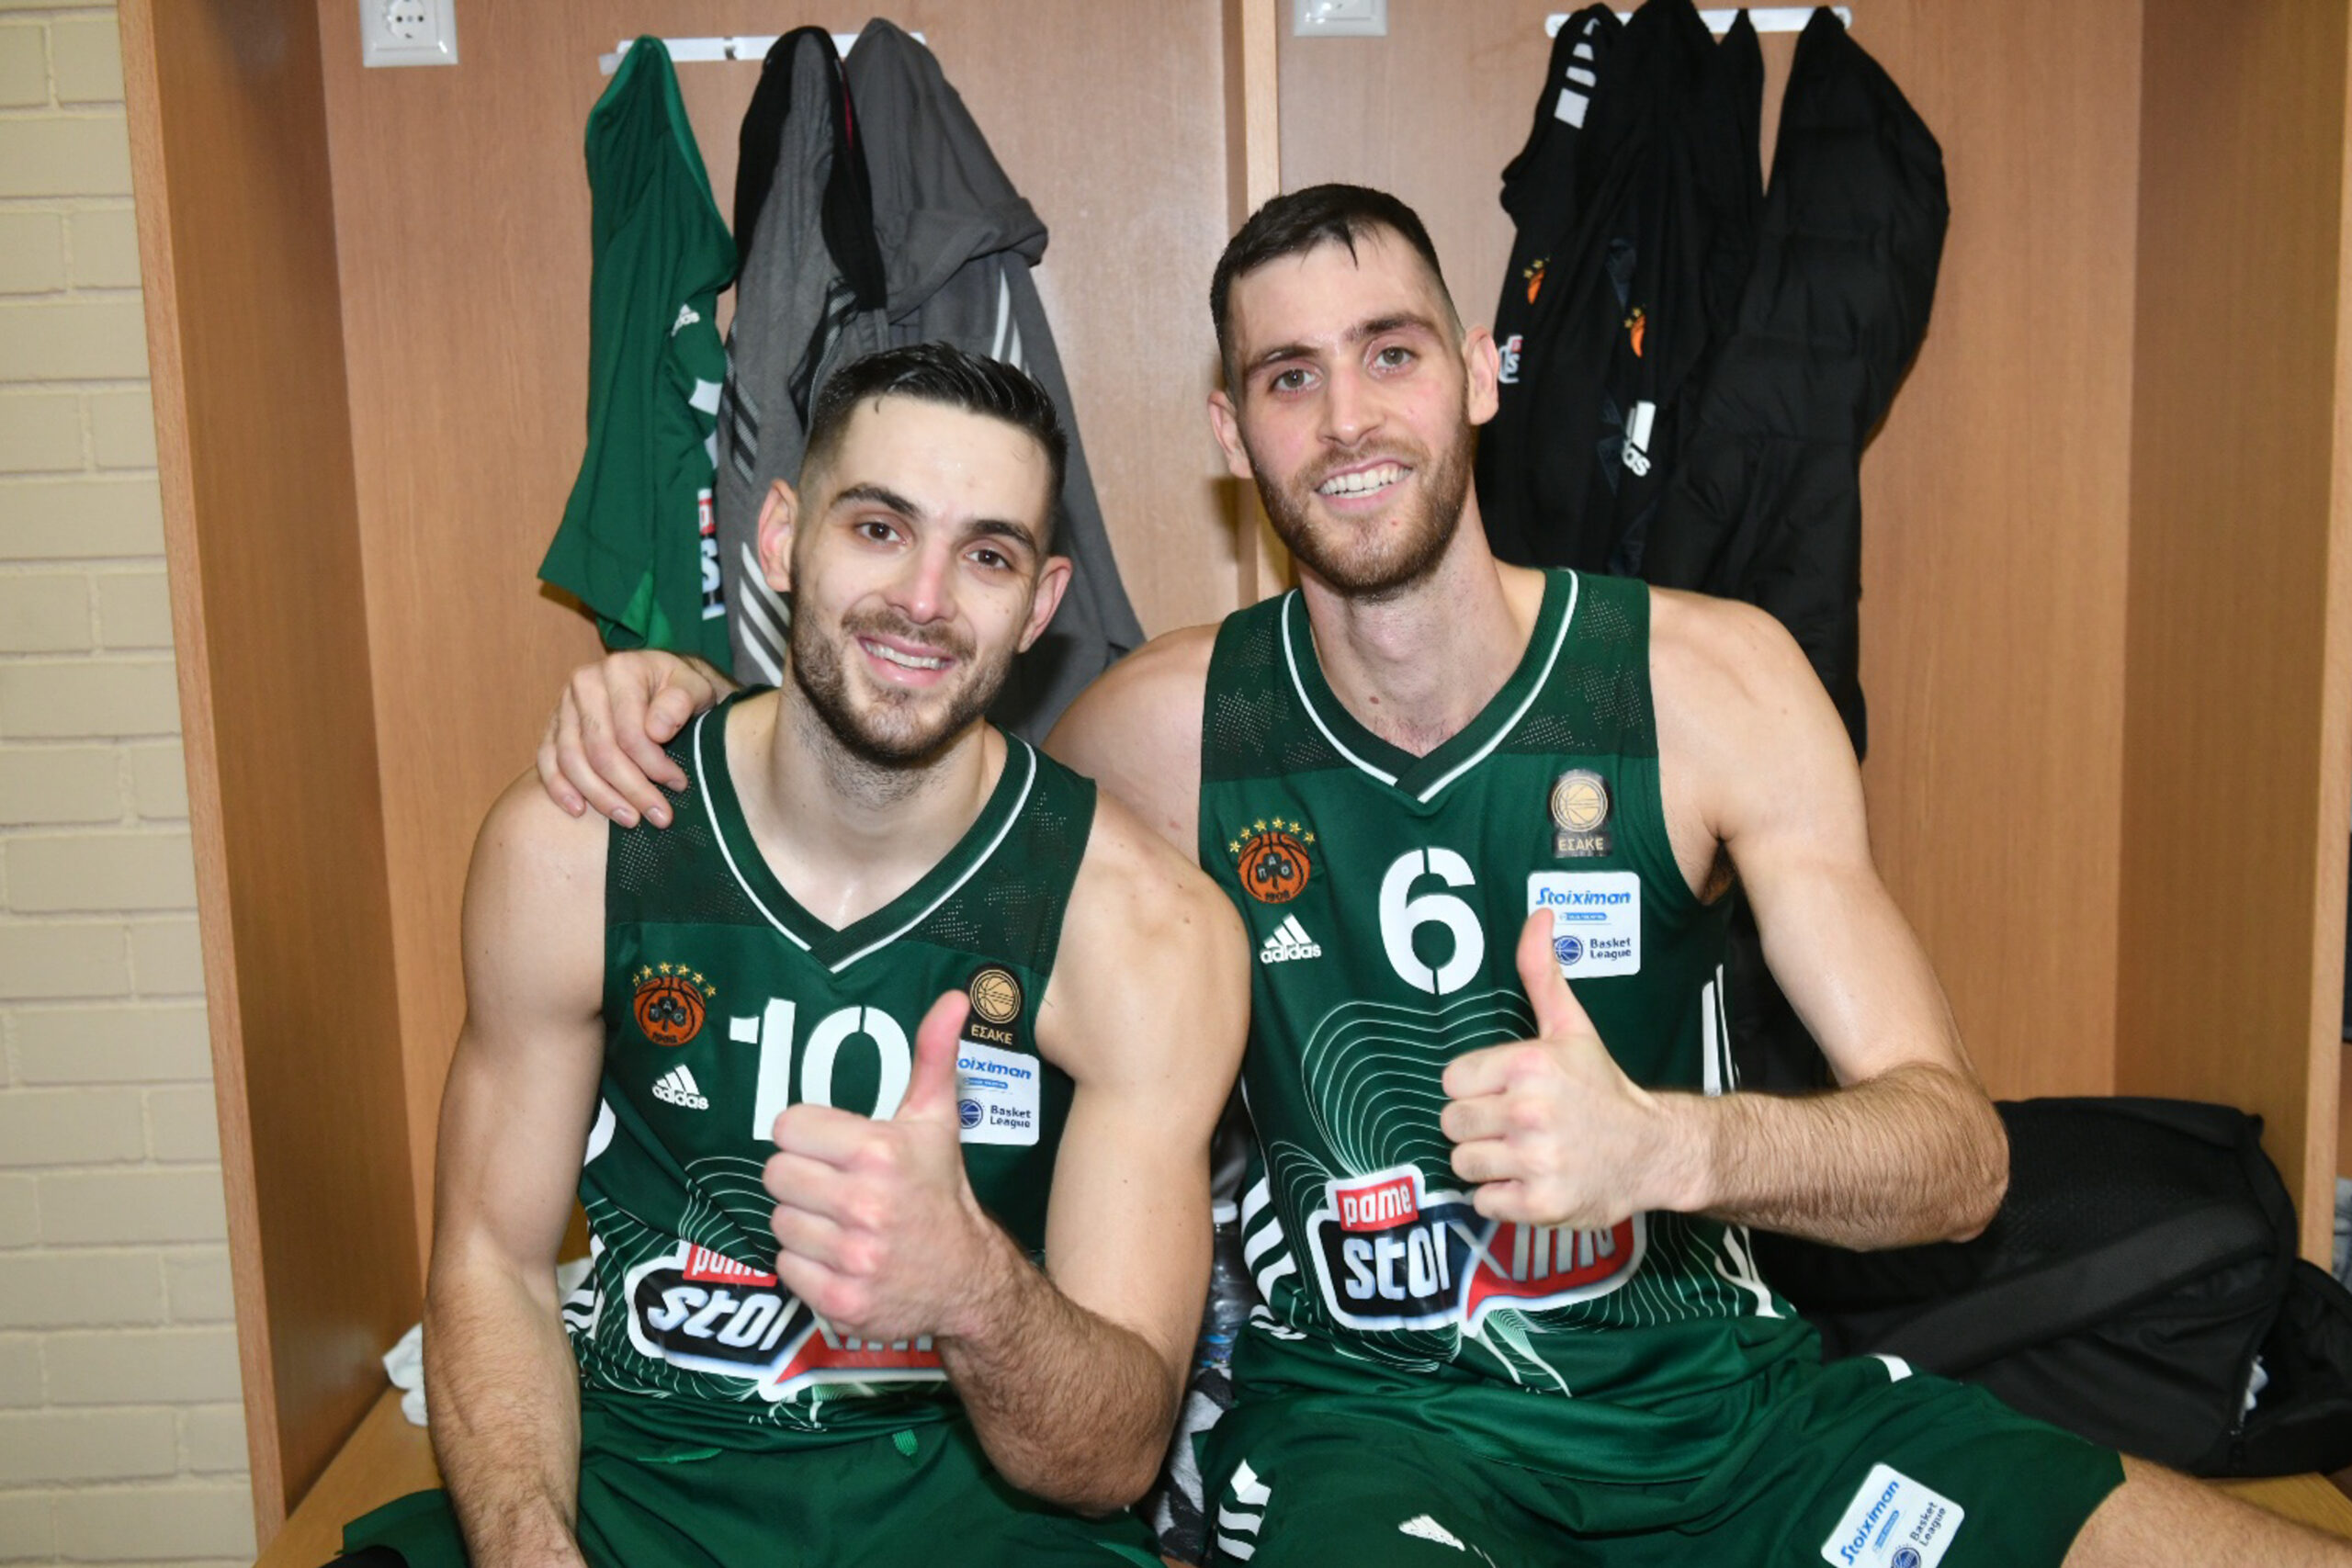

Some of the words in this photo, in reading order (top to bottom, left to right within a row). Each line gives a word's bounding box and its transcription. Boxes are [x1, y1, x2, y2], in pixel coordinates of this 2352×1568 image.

[1536, 886, 1632, 906] Stoiximan
[1379, 845, 1486, 996] 6
[1260, 942, 1323, 964] adidas
[1589, 937, 1632, 950] Basket
[1589, 949, 1633, 962] League
[729, 997, 912, 1142] 10
[957, 1056, 1032, 1080] oiximan
[651, 1084, 710, 1111] adidas
[989, 1104, 1032, 1119] Basket
[989, 1115, 1032, 1130] League
[1342, 1182, 1414, 1228] pame
[1840, 1480, 1900, 1566] Stoiximan
[1909, 1501, 1939, 1542] Basket
[1919, 1506, 1947, 1547] League
